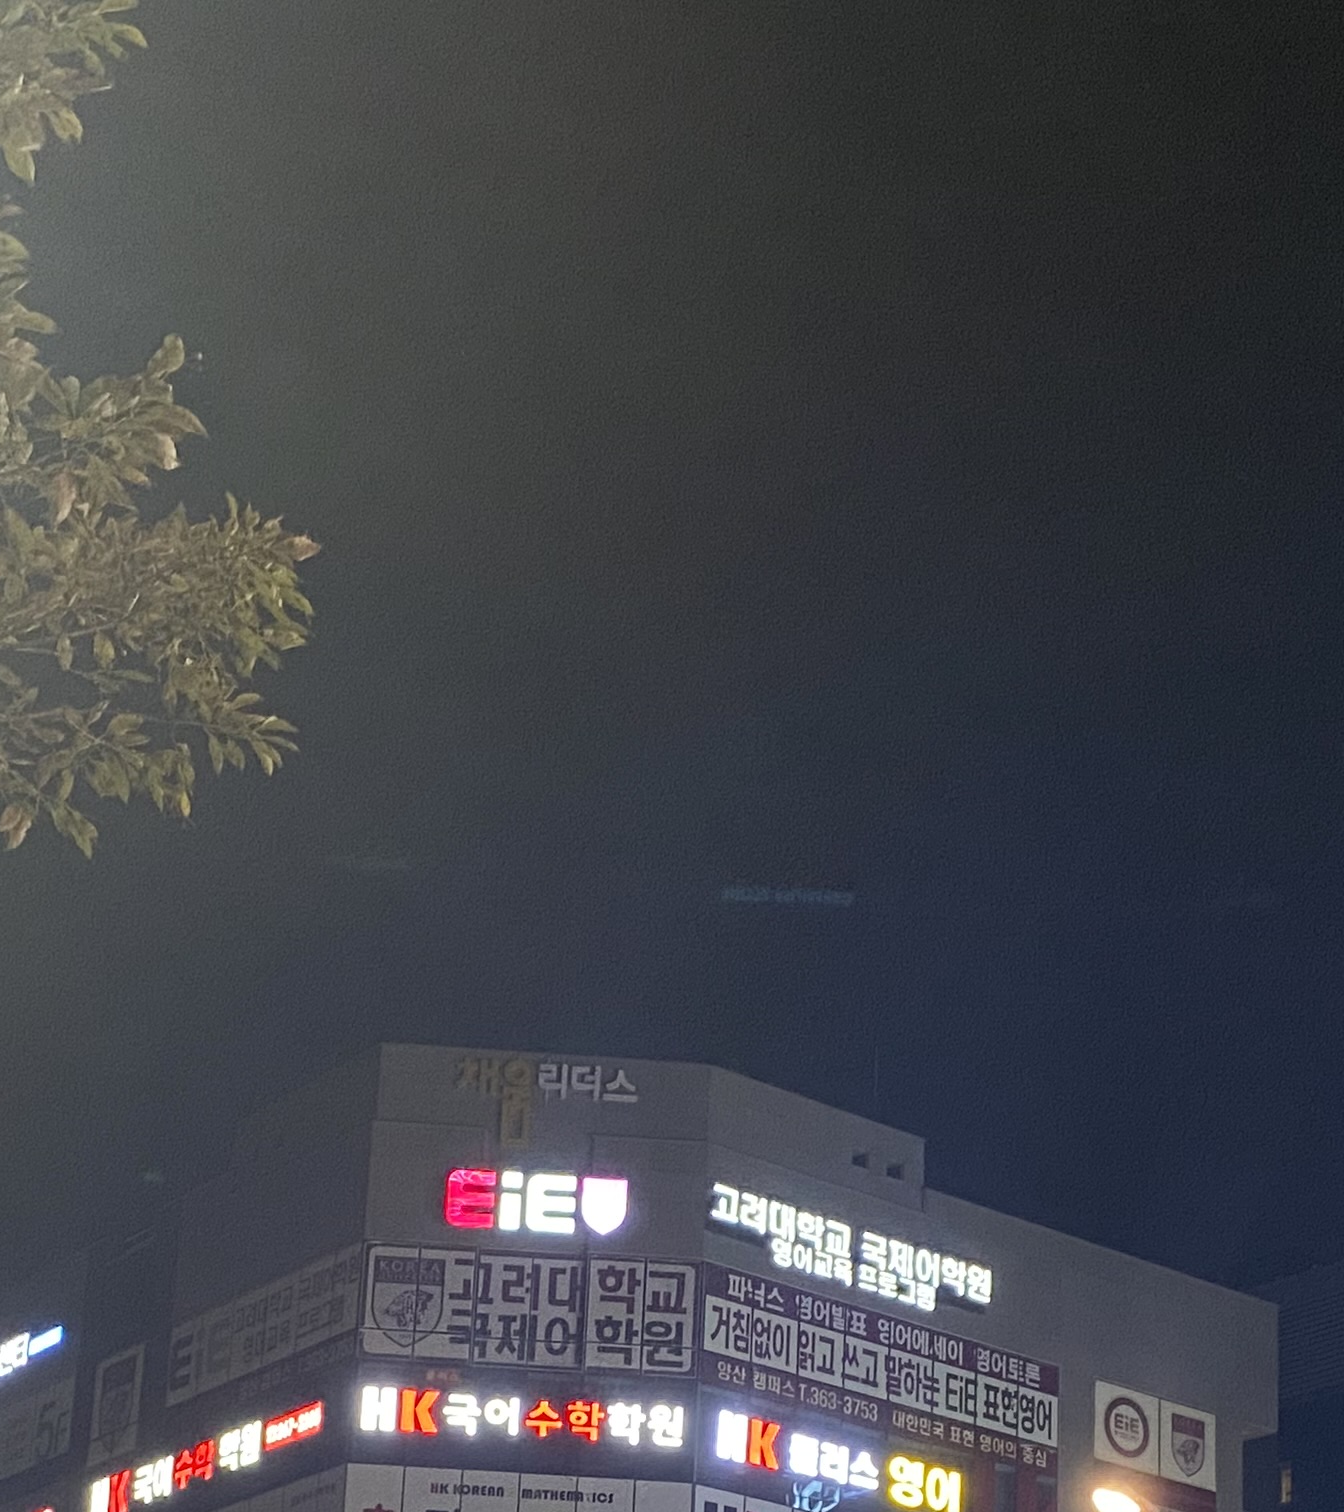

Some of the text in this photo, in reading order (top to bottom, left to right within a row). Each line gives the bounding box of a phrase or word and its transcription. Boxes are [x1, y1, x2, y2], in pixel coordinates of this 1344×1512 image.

[538, 1061, 639, 1104] 리더스
[709, 1181, 994, 1305] 고려대학교 국제어학원
[448, 1258, 690, 1315] 고려대학교
[770, 1236, 937, 1312] 영어교육 프로그램
[446, 1308, 687, 1369] 국제어학원
[710, 1304, 792, 1366] 거침없이
[717, 1361, 746, 1386] 양산
[788, 1432, 879, 1491] 플러스
[521, 1487, 615, 1504] MATHEMAICS
